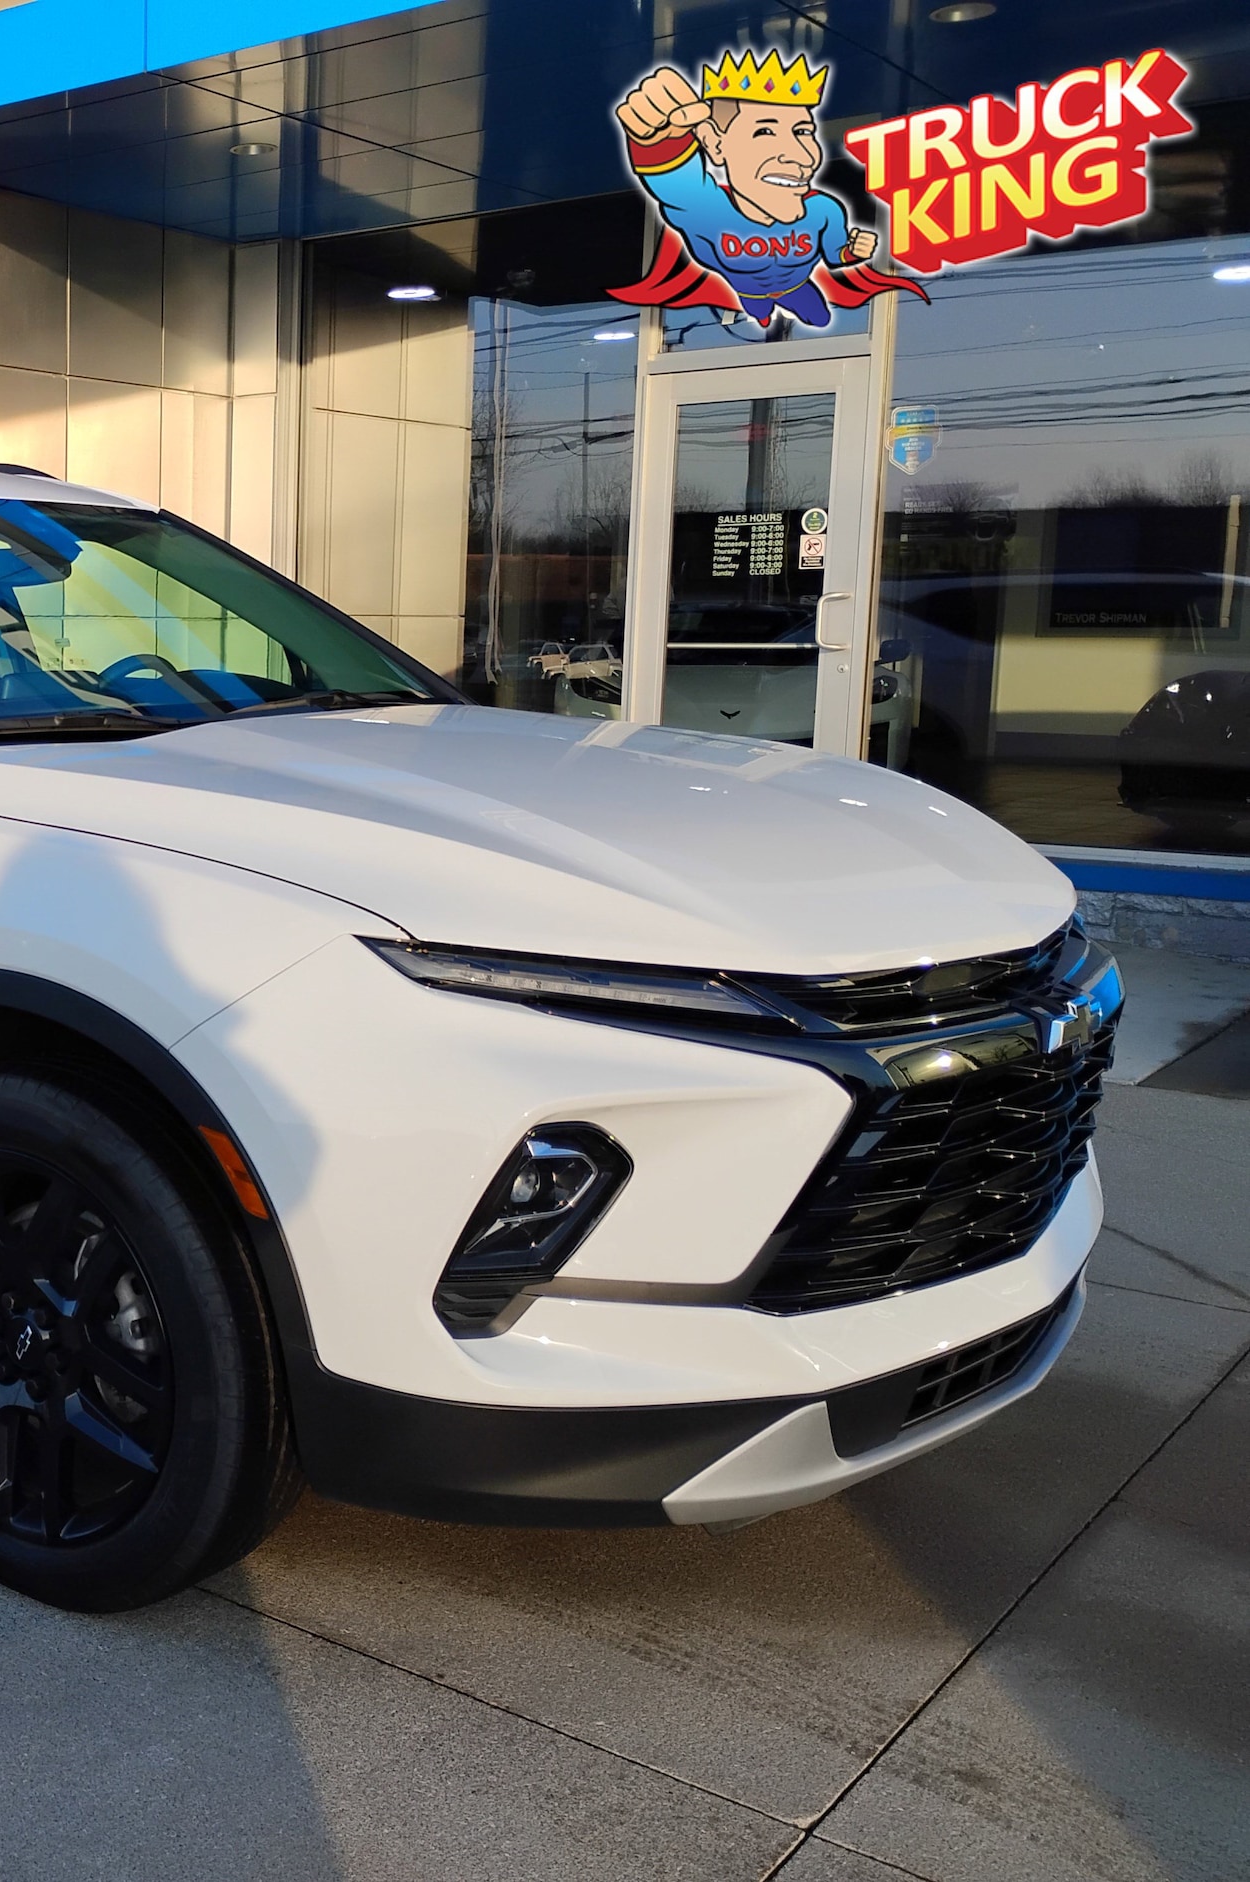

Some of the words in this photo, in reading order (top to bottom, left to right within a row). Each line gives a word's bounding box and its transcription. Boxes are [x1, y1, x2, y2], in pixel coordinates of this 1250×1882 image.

[717, 514, 748, 524] SALES
[749, 512, 783, 523] HOURS
[751, 525, 785, 533] 9:00-7:00
[713, 548, 742, 556] Thursday
[713, 555, 733, 563] Friday
[748, 568, 781, 576] CLOSED
[1054, 612, 1096, 624] TREVOR
[1099, 611, 1147, 624] SHIPMAN
